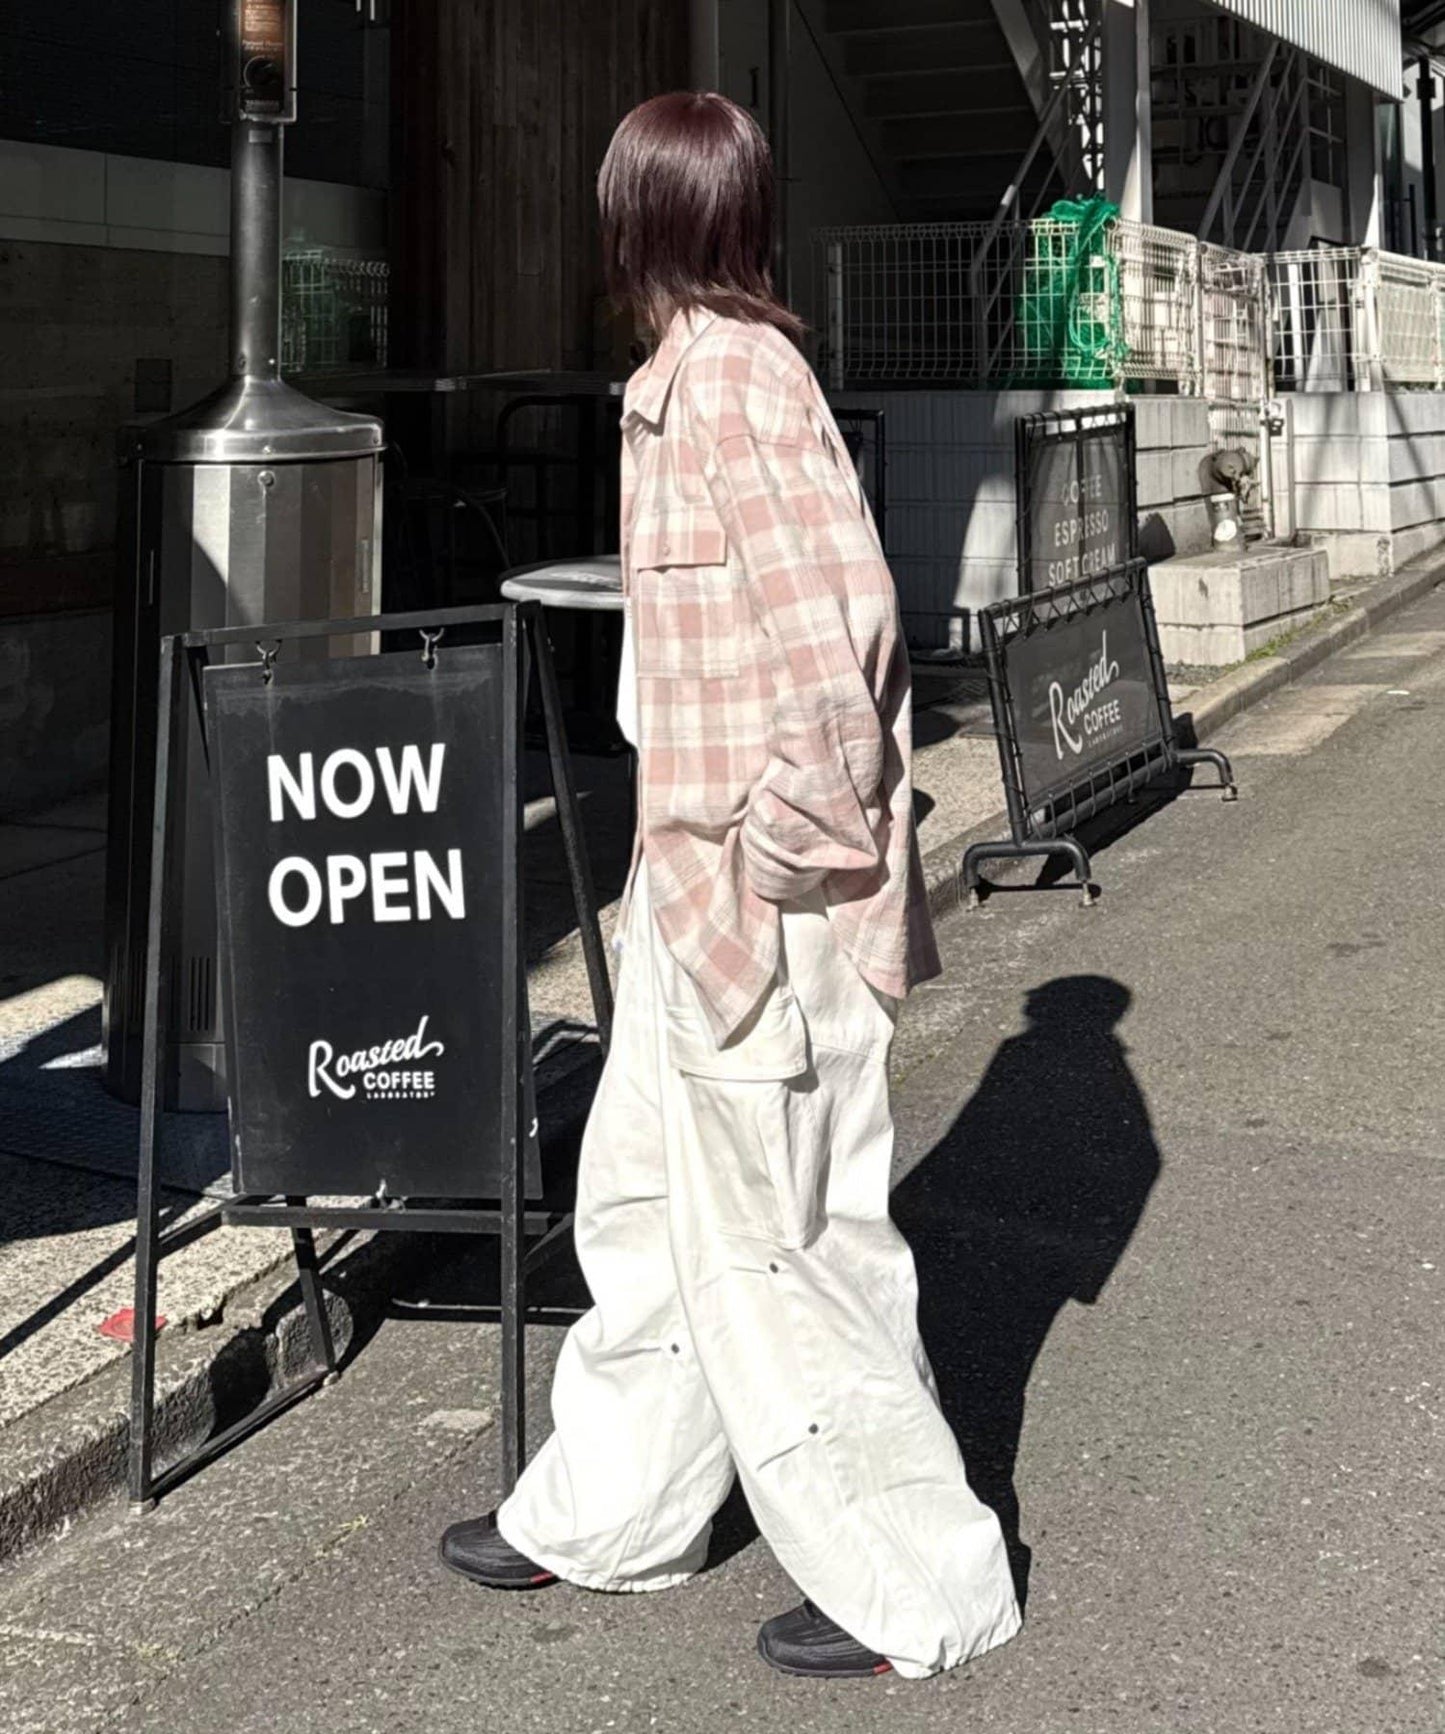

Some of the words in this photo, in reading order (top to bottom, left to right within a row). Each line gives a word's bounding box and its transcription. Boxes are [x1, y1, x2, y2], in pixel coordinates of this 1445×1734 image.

[1061, 474, 1102, 506] COFEE
[1055, 509, 1108, 547] ESPRESSO
[1048, 556, 1079, 586] SOFT
[1082, 543, 1116, 574] CREAM
[1048, 629, 1119, 760] Roasted
[1084, 699, 1121, 735] COFFEE
[267, 743, 446, 822] NOW
[268, 848, 466, 927] OPEN
[308, 1015, 444, 1100] Roasted
[363, 1071, 435, 1090] COFFEE
